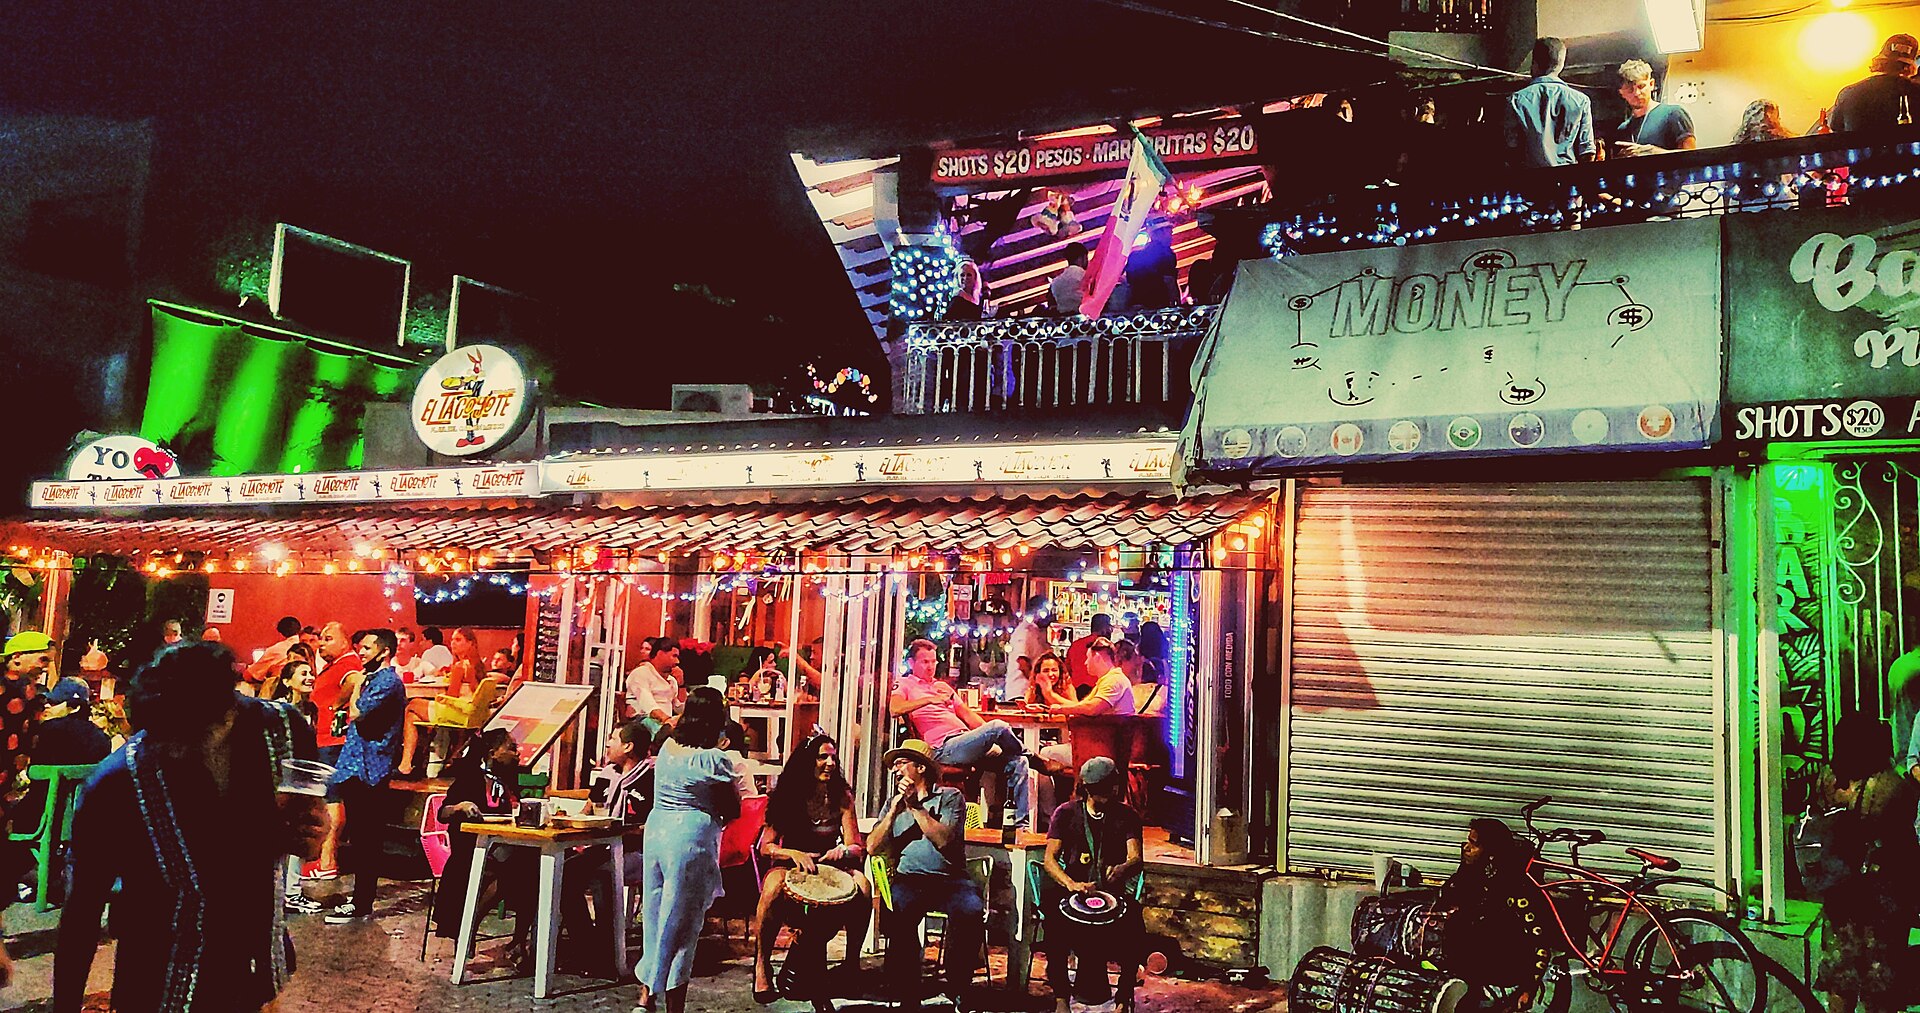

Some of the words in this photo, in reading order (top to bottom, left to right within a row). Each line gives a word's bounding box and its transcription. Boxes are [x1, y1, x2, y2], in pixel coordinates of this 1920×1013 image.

[937, 154, 988, 177] SHOTS
[993, 148, 1030, 177] $20
[1035, 147, 1082, 170] PESOS
[1092, 132, 1206, 163] MARRITAS
[1213, 126, 1255, 155] $20
[1329, 258, 1588, 339] MONEY
[438, 390, 514, 420] TACOYOTE
[1735, 403, 1842, 440] SHOTS
[1846, 407, 1880, 426] $20
[93, 445, 130, 469] YO
